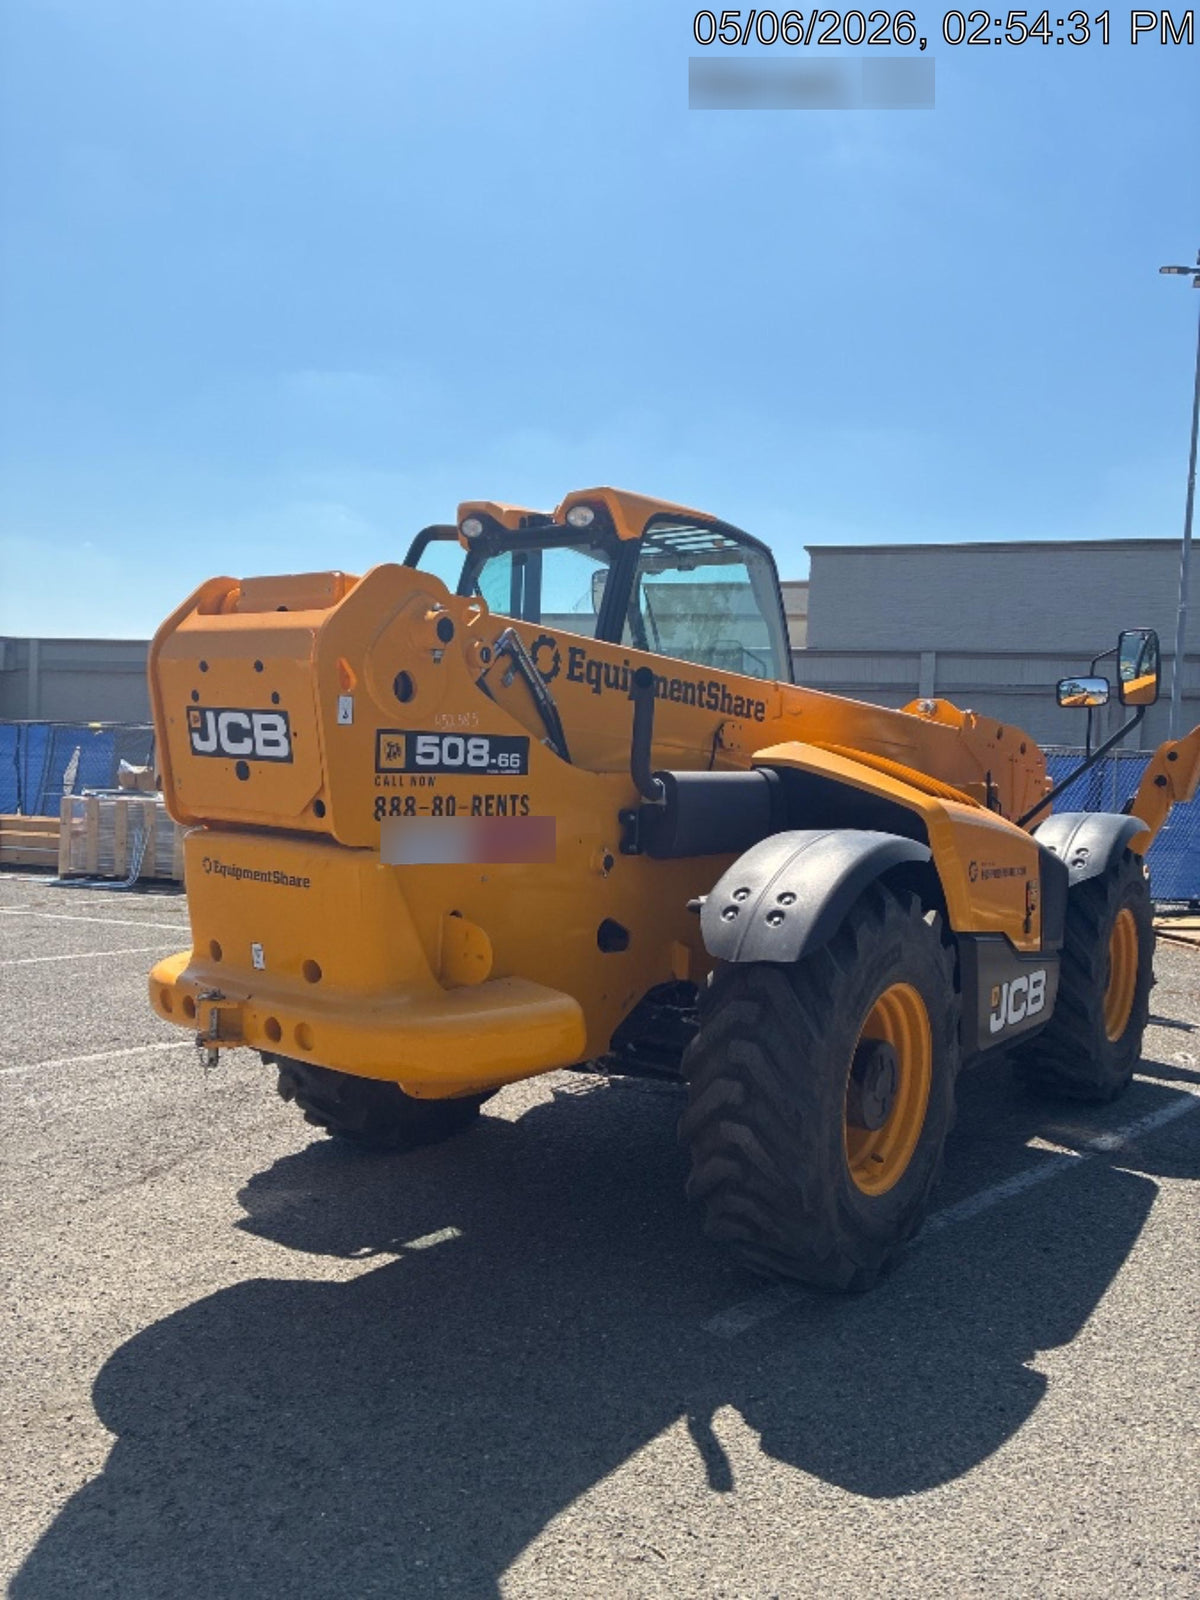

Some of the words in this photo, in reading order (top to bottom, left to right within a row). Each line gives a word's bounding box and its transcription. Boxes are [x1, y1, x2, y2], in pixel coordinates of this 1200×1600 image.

[192, 710, 290, 758] JCB
[415, 735, 521, 768] 508-66
[374, 775, 404, 788] CALL
[410, 775, 437, 788] NOW
[373, 794, 530, 822] 888-80-RENTS
[213, 859, 311, 888] EquipmentShare
[990, 969, 1047, 1034] JCB
